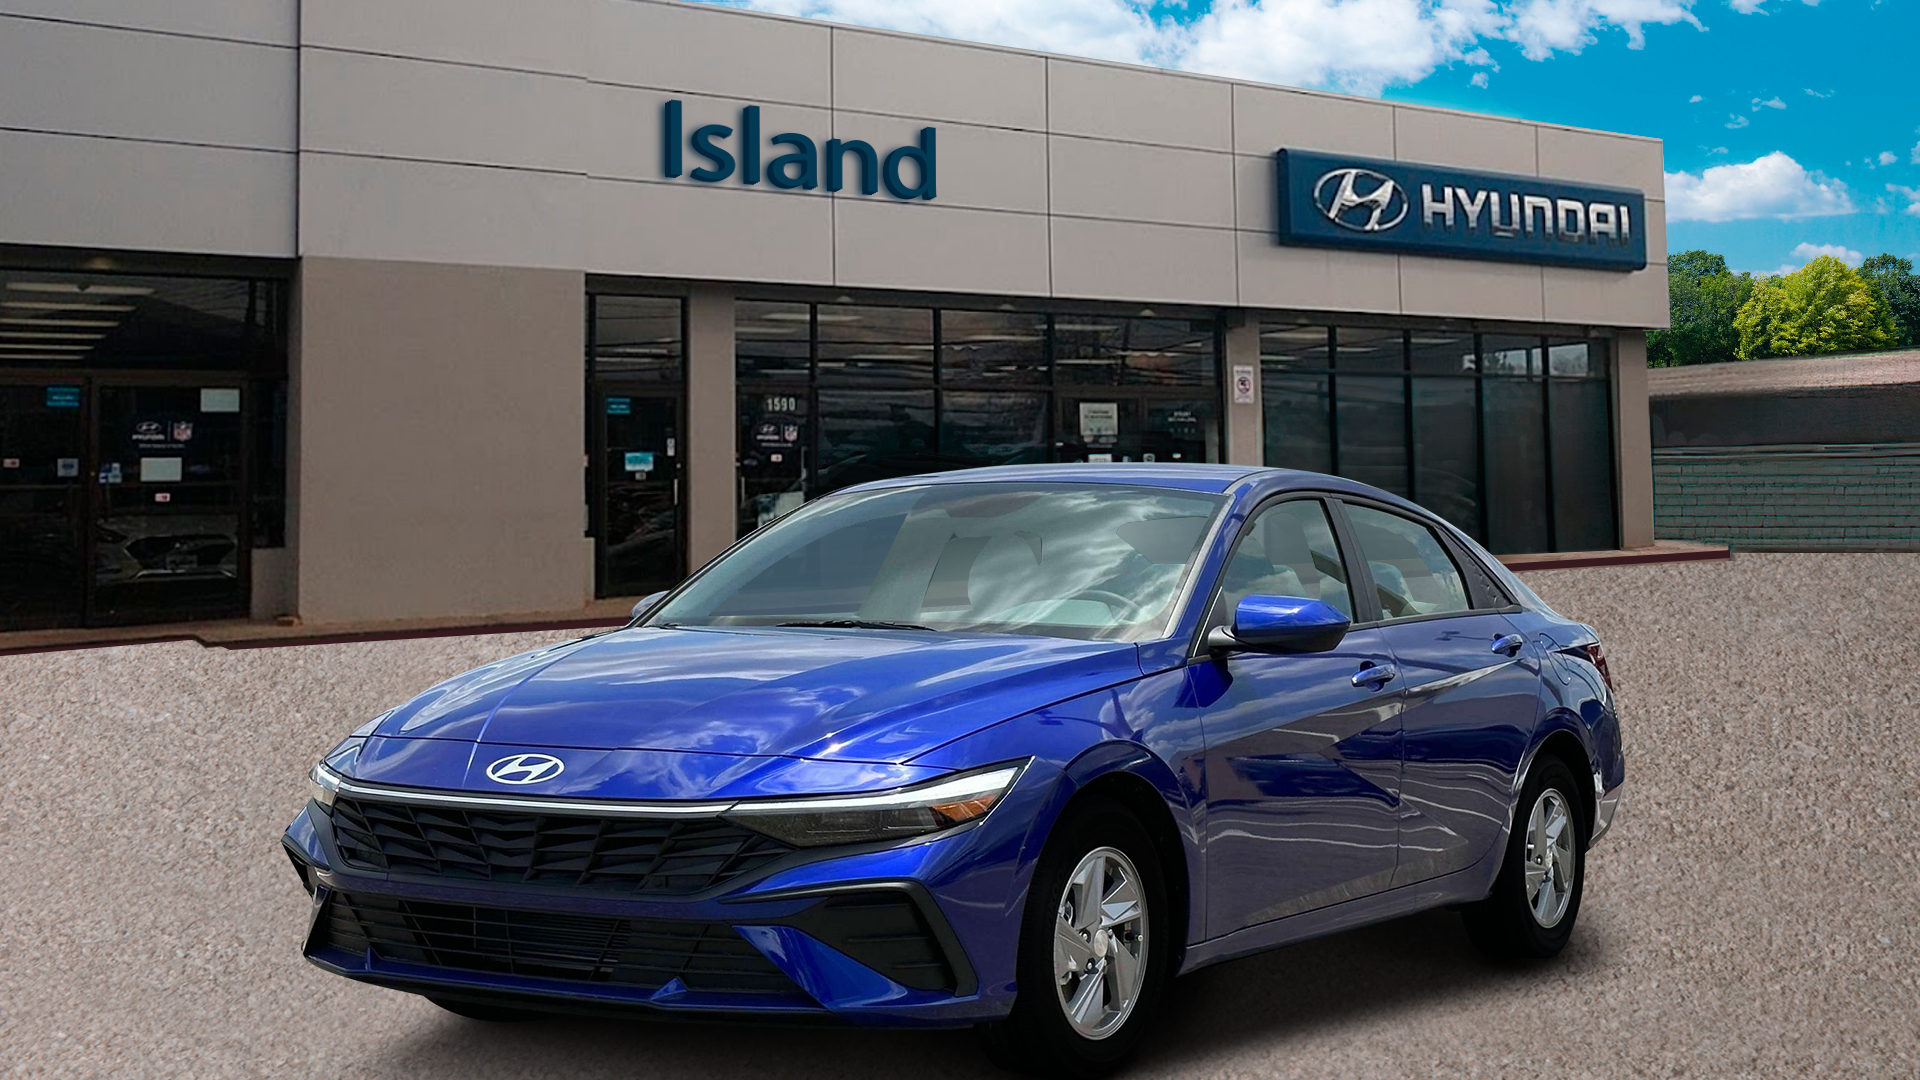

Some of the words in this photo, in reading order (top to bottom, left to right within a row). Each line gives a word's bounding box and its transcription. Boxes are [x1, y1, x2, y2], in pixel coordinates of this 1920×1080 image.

[663, 99, 937, 201] Island
[1421, 183, 1631, 244] HYUNDAI
[767, 397, 796, 411] 1590
